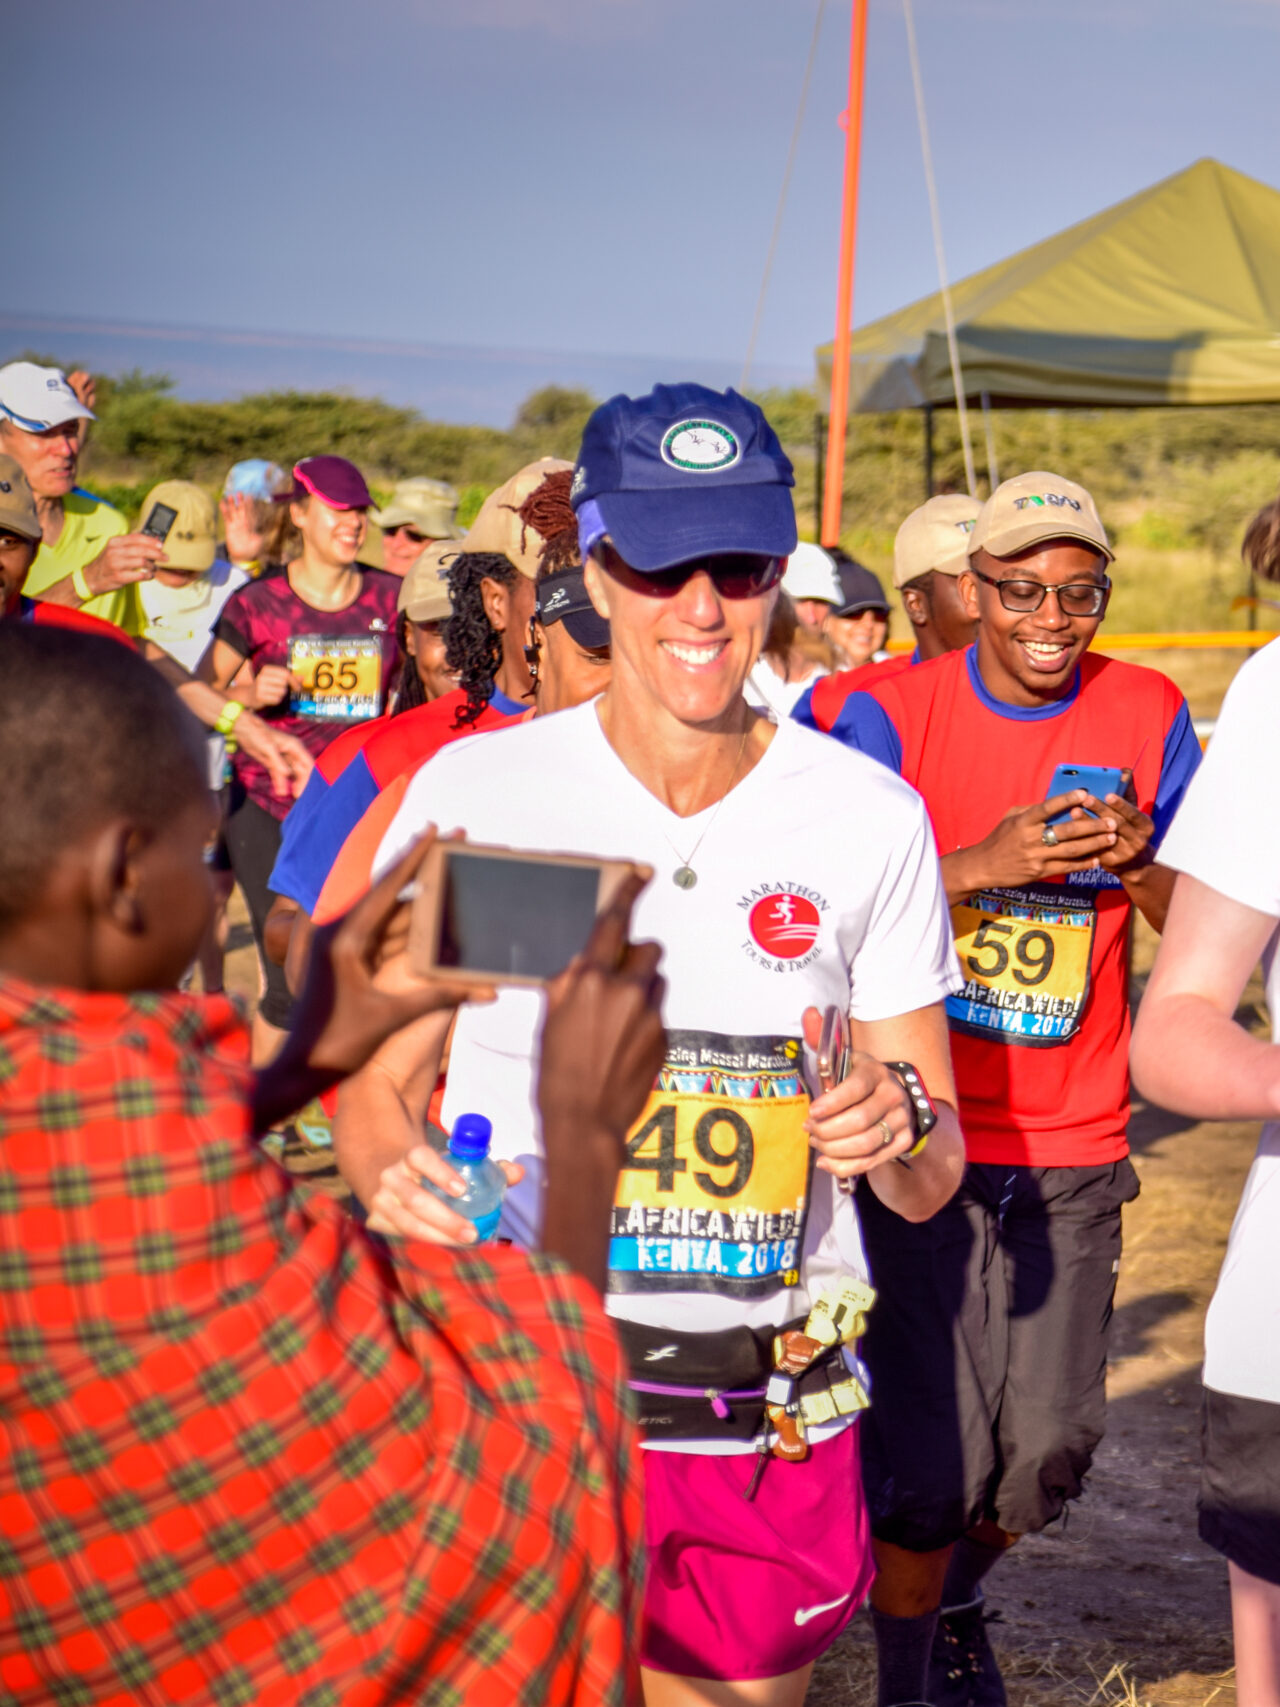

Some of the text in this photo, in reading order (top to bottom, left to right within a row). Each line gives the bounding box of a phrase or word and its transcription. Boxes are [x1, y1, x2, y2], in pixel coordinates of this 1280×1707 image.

[313, 661, 358, 691] 65
[1068, 871, 1120, 886] MARATHON
[736, 881, 831, 912] MARATHON
[741, 939, 823, 974] TOURS & TRAVEL
[967, 919, 1055, 986] 59
[1031, 1014, 1073, 1037] 2018
[666, 1047, 697, 1067] zing
[700, 1048, 745, 1069] Maasai
[625, 1105, 755, 1199] 49
[610, 1198, 804, 1241] .AFRICA.WILD!
[736, 1238, 797, 1275] 2018
